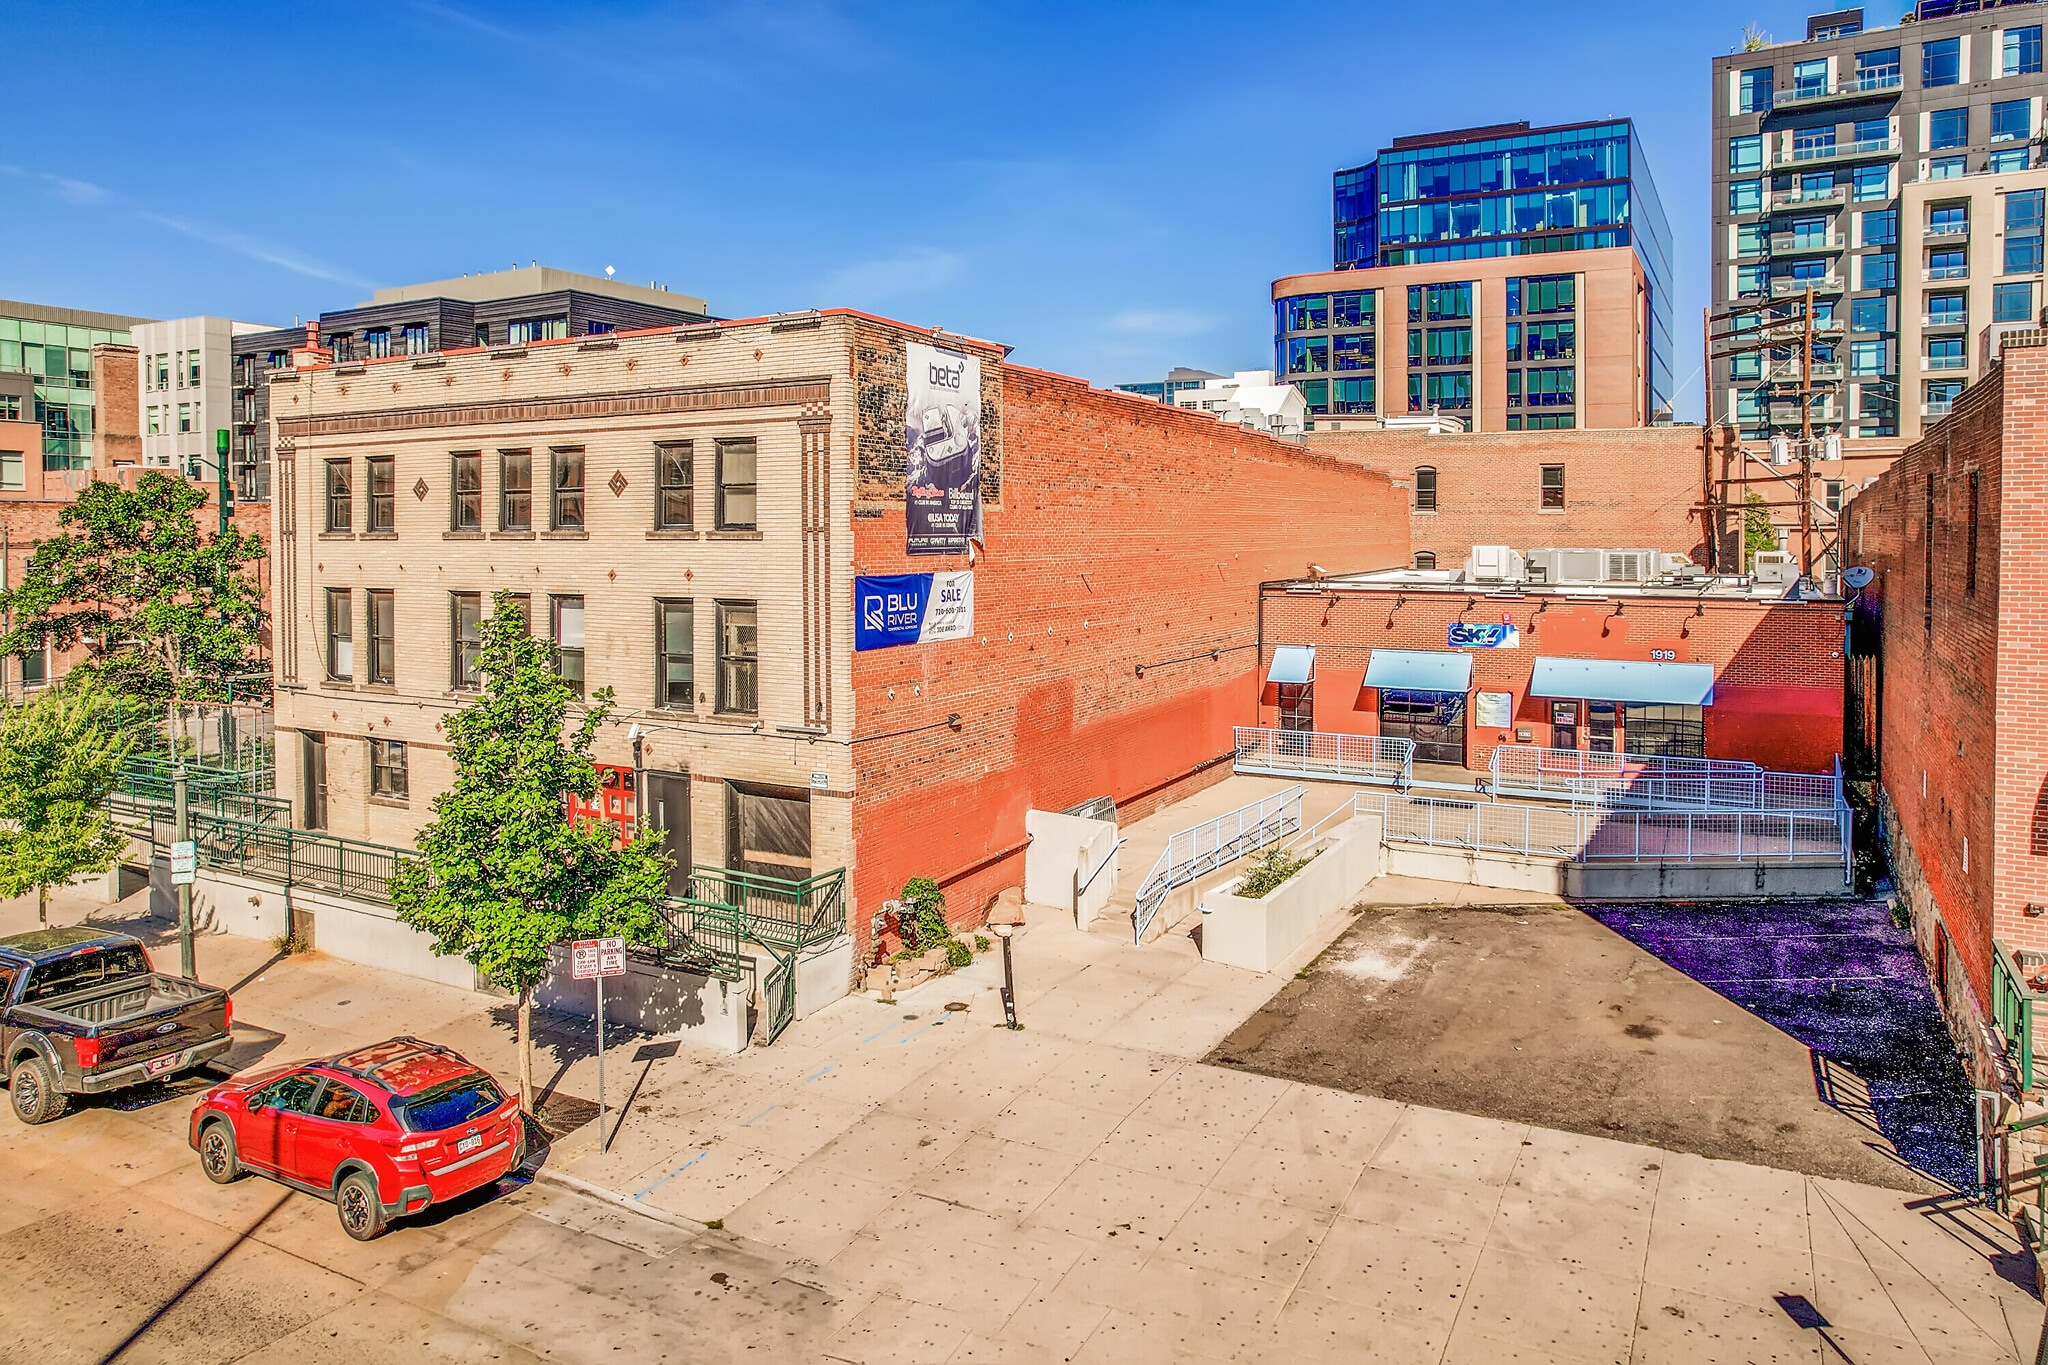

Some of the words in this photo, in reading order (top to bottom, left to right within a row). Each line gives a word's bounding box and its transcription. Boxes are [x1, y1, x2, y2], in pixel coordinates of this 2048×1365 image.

[929, 361, 960, 388] beta
[948, 488, 974, 500] Billboard
[933, 514, 943, 522] USA
[943, 514, 959, 522] TODAY
[940, 589, 961, 602] SALE
[887, 593, 918, 612] BLU
[887, 613, 918, 626] RIVER
[1650, 649, 1676, 660] 1919
[601, 947, 622, 955] PARKING
